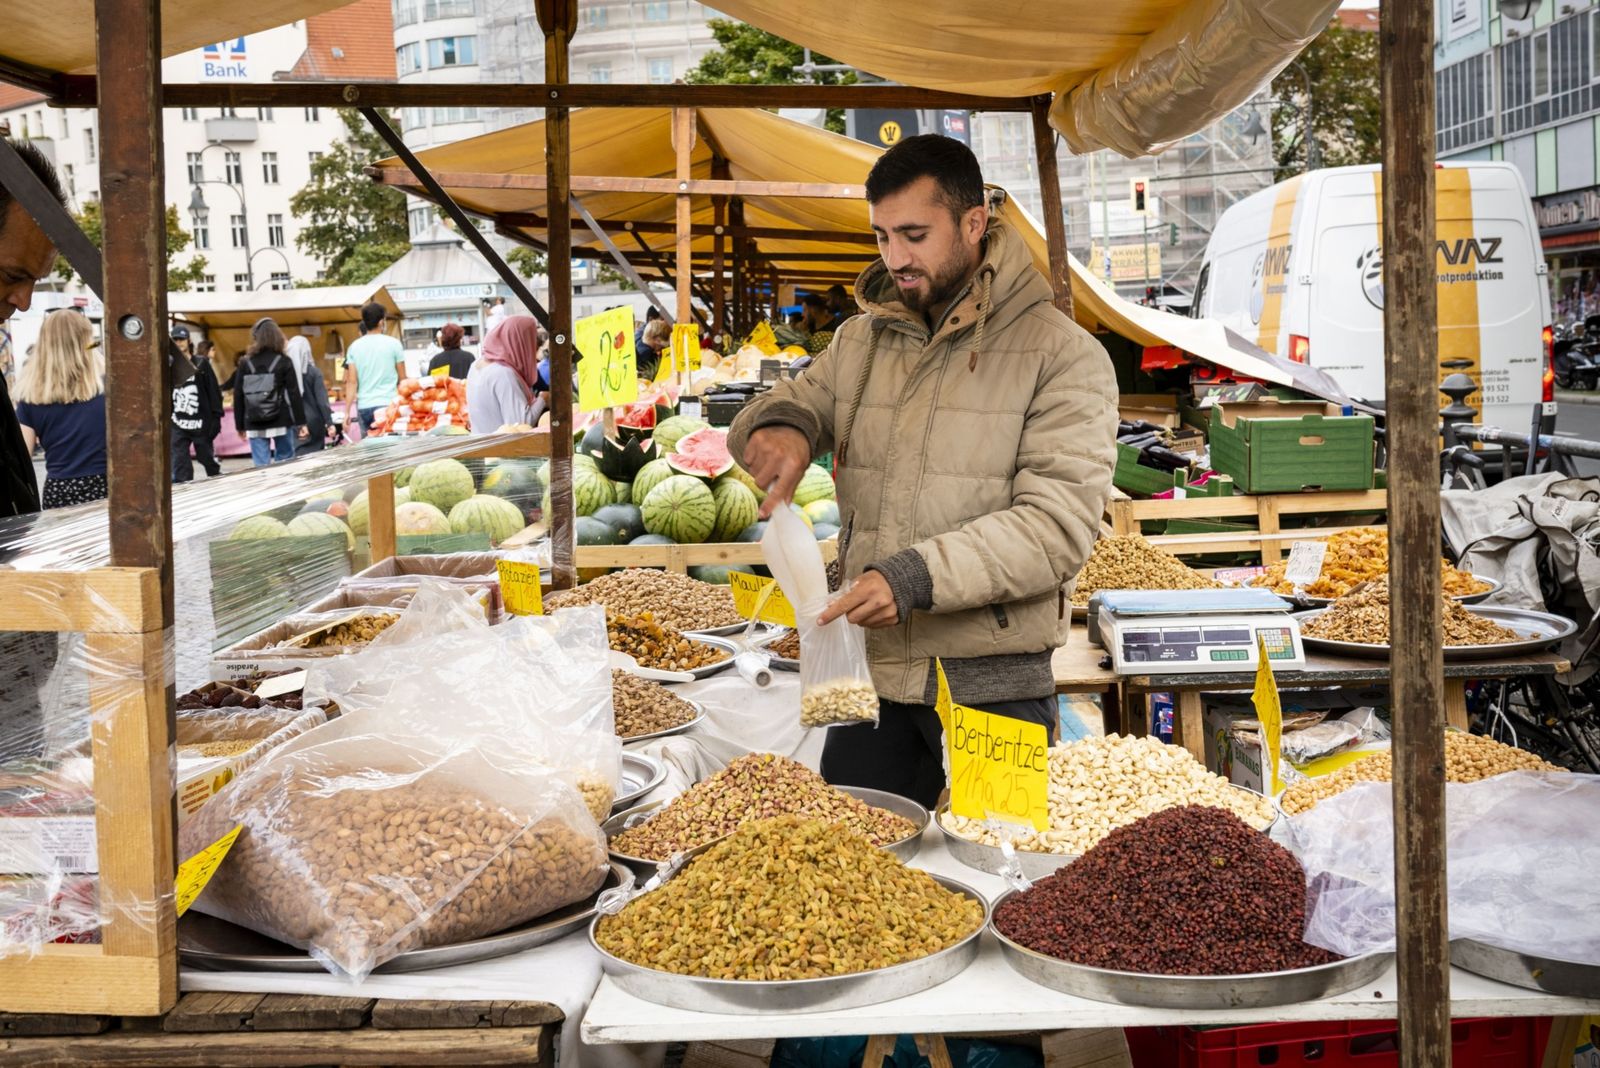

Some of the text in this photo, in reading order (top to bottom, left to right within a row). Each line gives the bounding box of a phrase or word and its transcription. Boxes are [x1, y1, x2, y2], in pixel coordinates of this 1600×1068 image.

[204, 62, 247, 77] Bank
[1436, 269, 1504, 284] rotproduktion
[1497, 384, 1509, 392] 521
[1497, 395, 1509, 403] 522
[953, 706, 1046, 773] Berberitze
